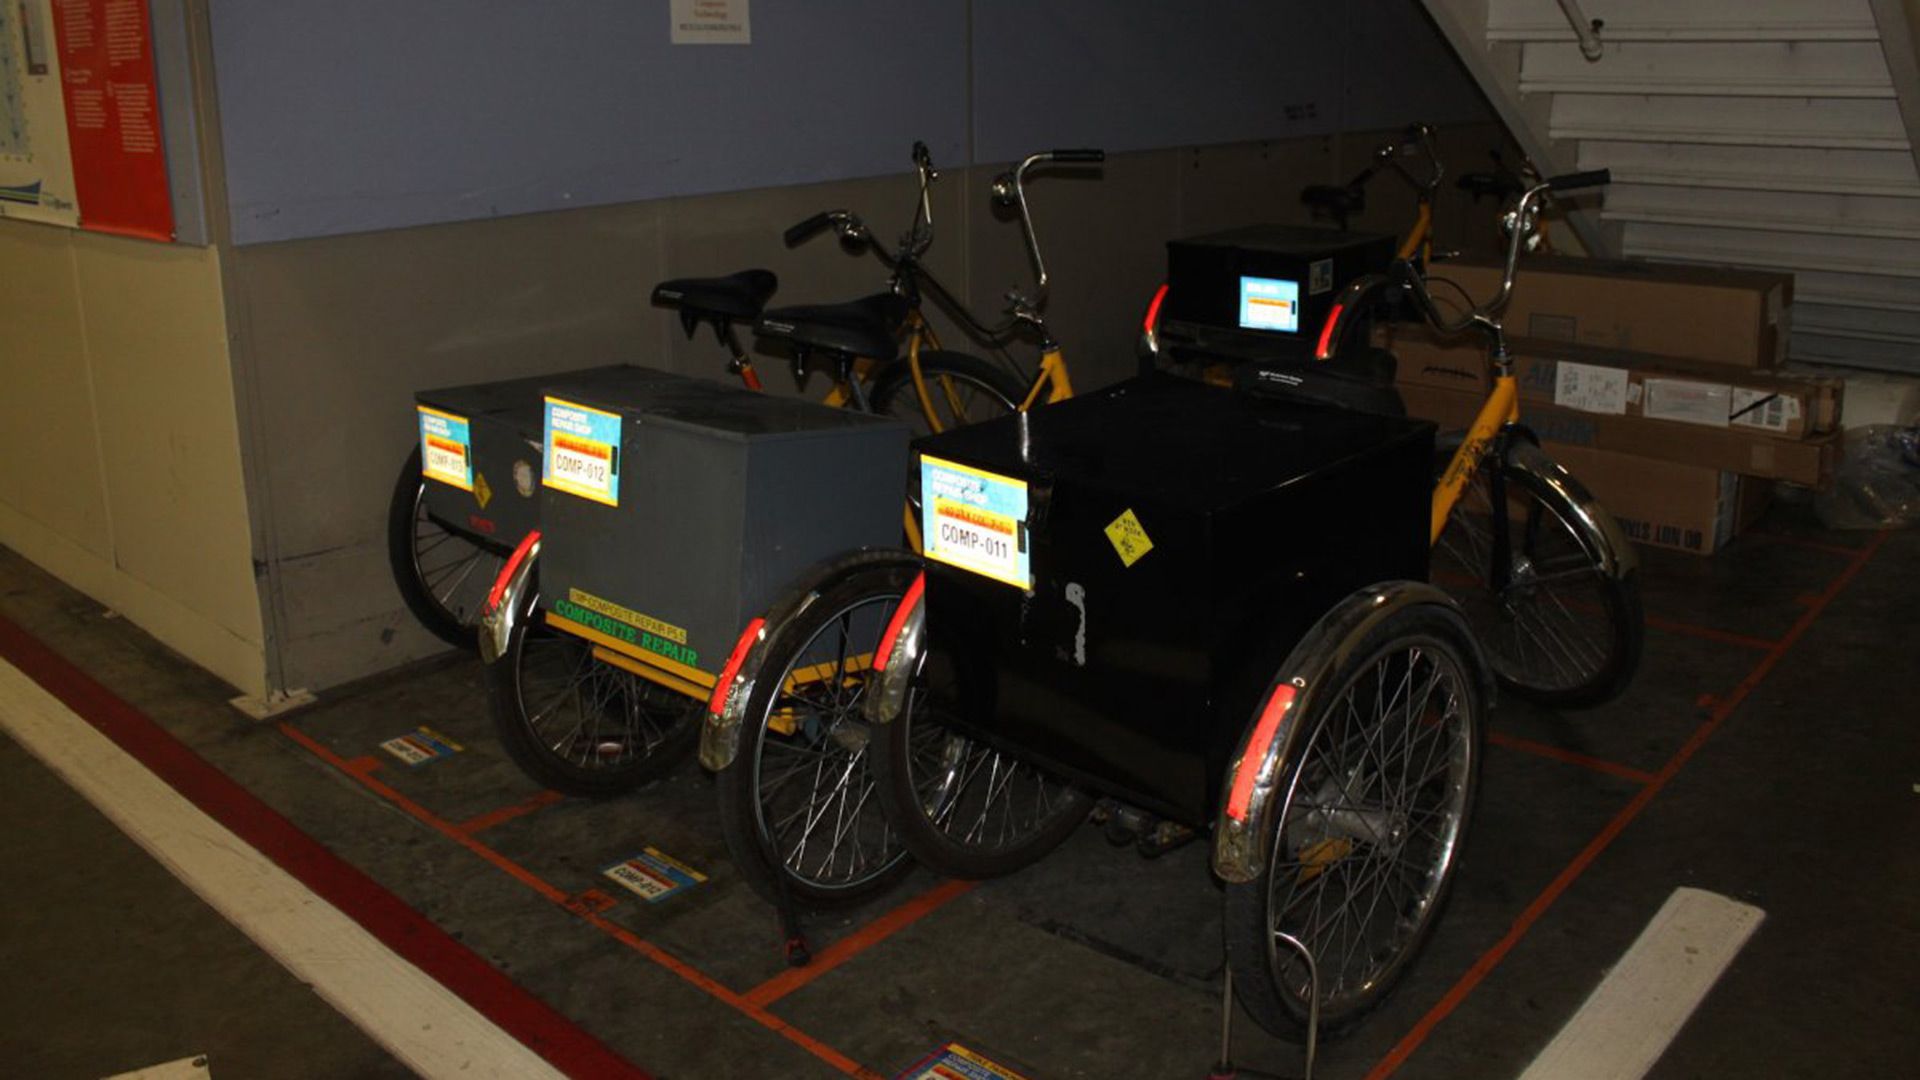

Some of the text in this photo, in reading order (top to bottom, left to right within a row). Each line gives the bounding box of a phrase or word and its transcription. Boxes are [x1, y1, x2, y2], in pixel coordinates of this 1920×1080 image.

[556, 453, 605, 482] COMP-012
[941, 523, 1008, 559] COMP-011
[554, 599, 698, 667] COMPOSITE REPAIR
